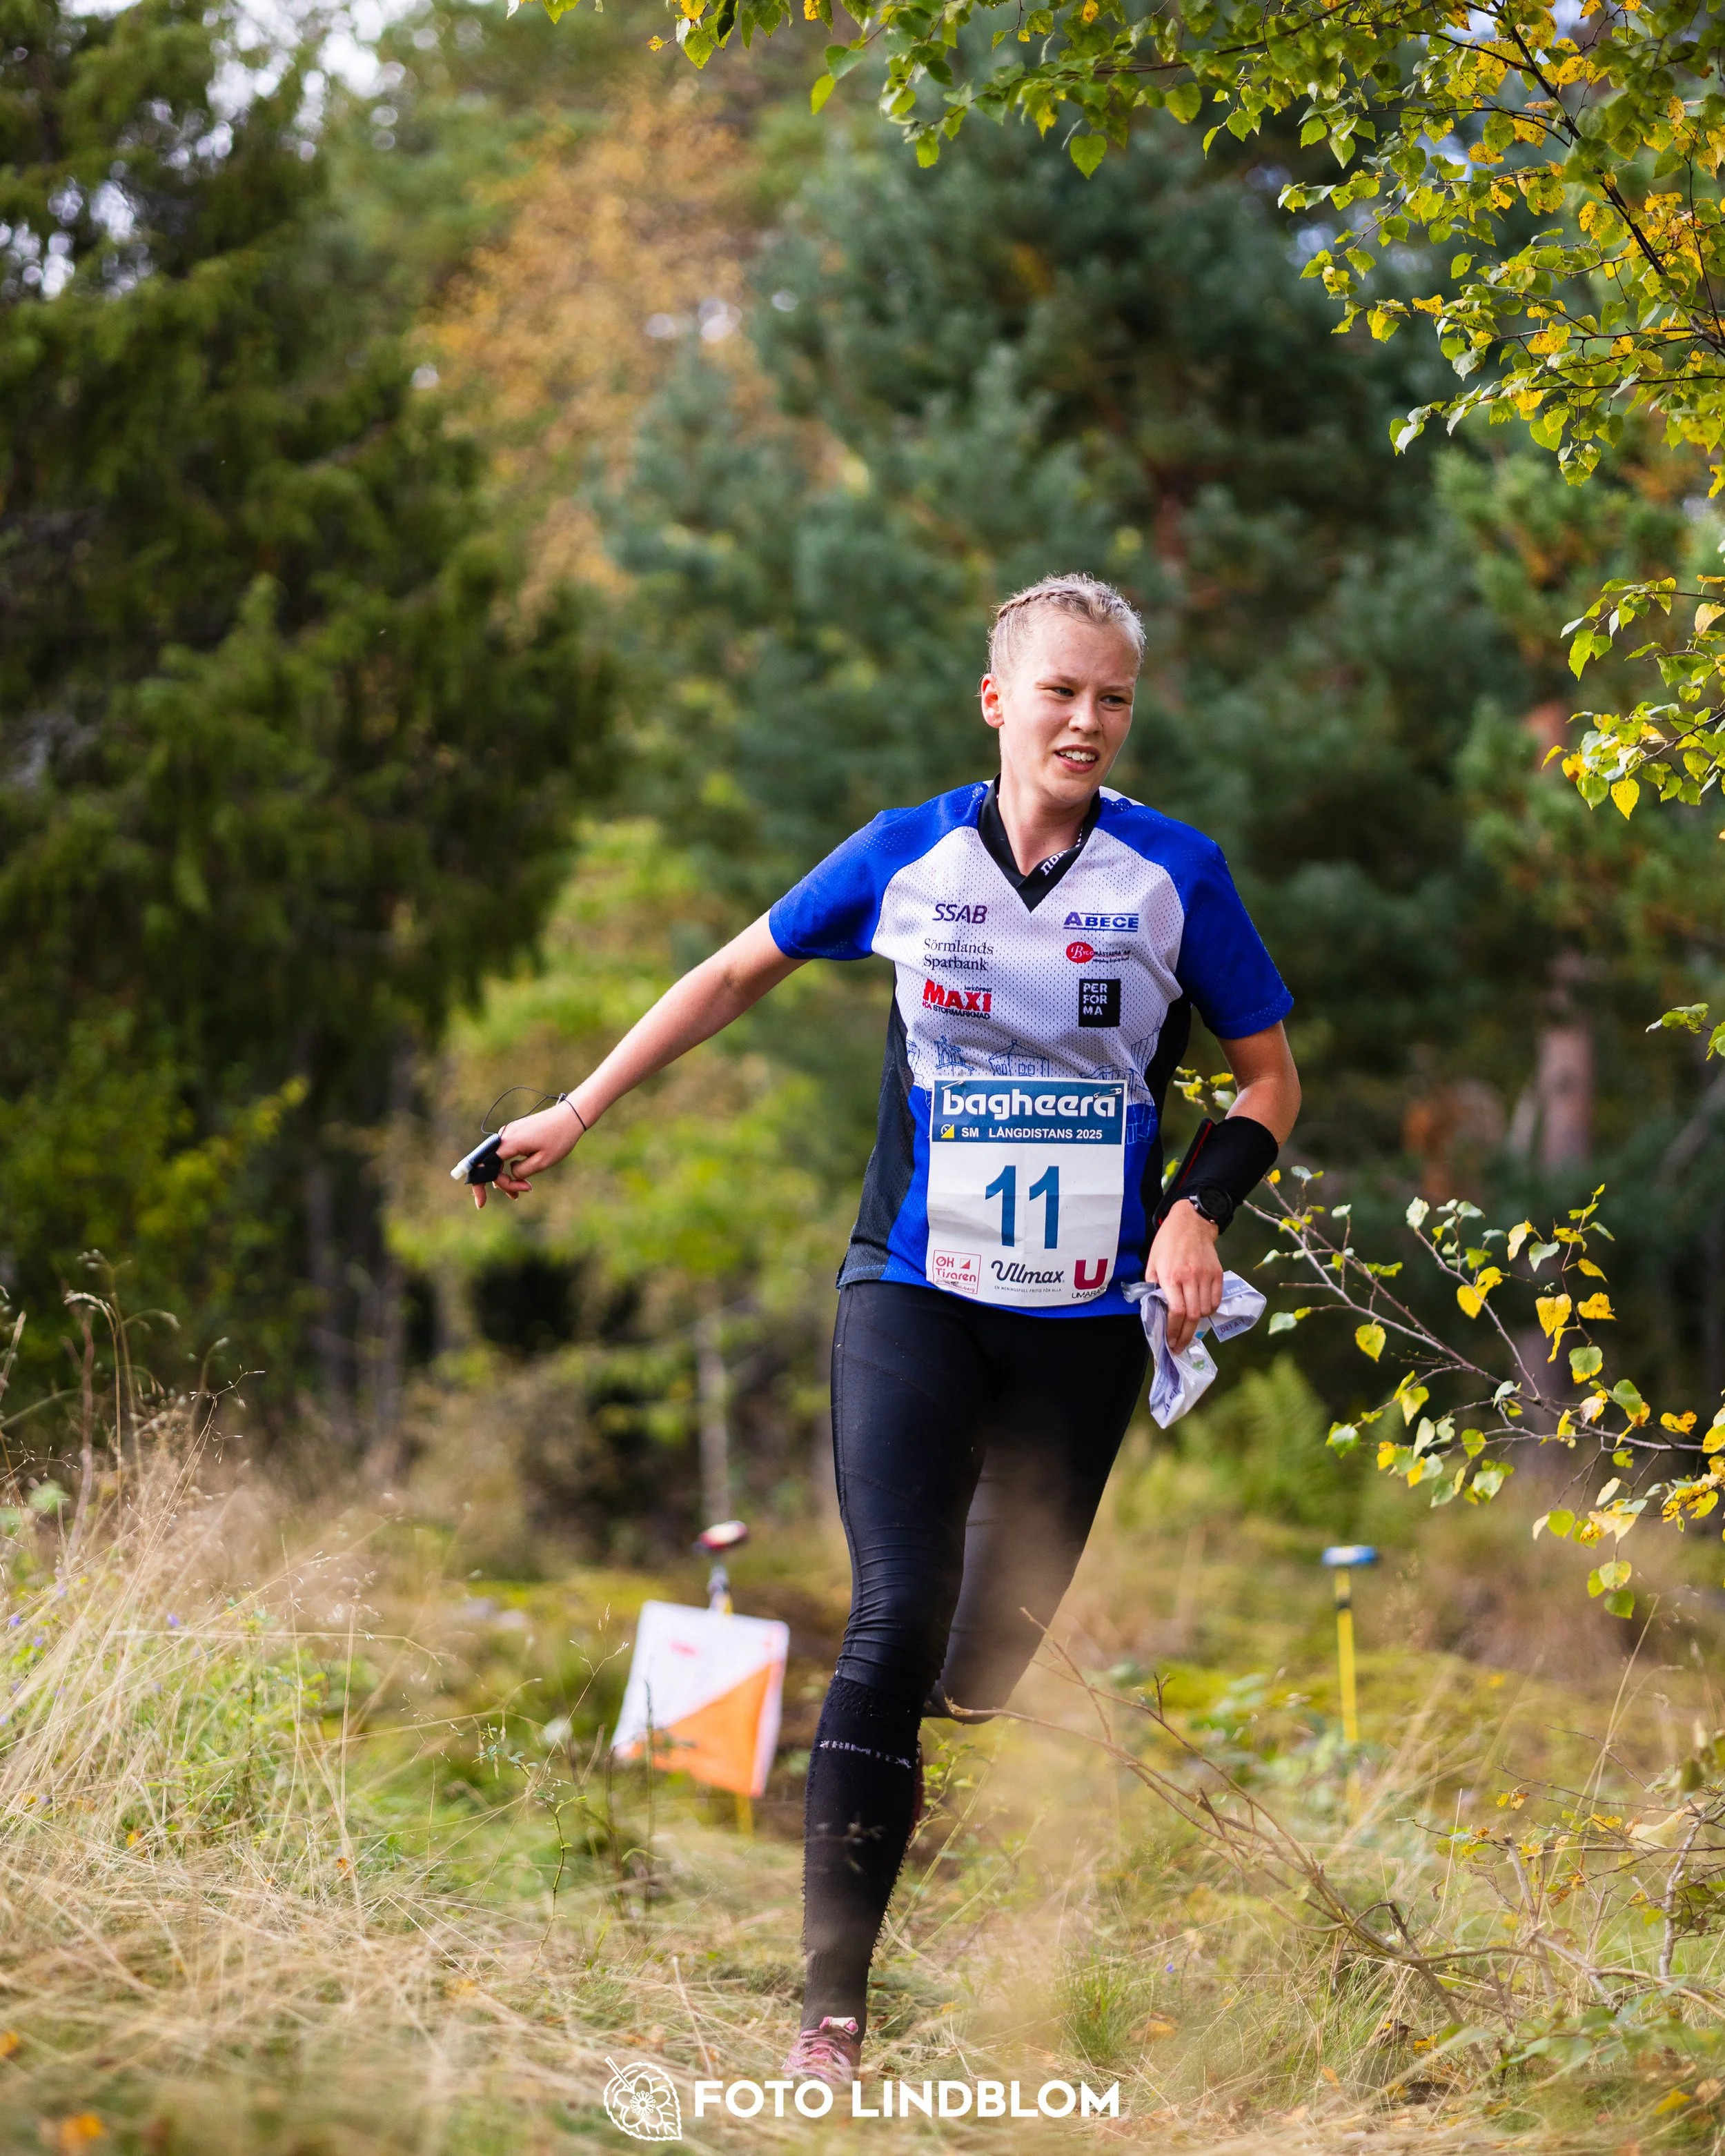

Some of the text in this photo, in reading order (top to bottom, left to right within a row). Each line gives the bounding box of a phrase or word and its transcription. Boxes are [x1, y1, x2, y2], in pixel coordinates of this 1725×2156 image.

[931, 903, 987, 924] SSAB
[1063, 911, 1138, 929] ABECE
[923, 938, 994, 955] Sörmlands
[923, 954, 988, 971] Sparbank
[923, 978, 992, 1012] MAXI
[1083, 983, 1107, 993] PER
[1083, 994, 1107, 1004] FOR
[933, 1005, 991, 1020] STORMARKNAD
[1083, 1005, 1103, 1015] MA
[943, 1089, 1116, 1120] bagheera
[961, 1126, 1103, 1139] SM LÅNGDISTANS 2025
[985, 1165, 1060, 1249] 11
[935, 1267, 976, 1282] Tisaren
[991, 1260, 1064, 1284] Ullmax
